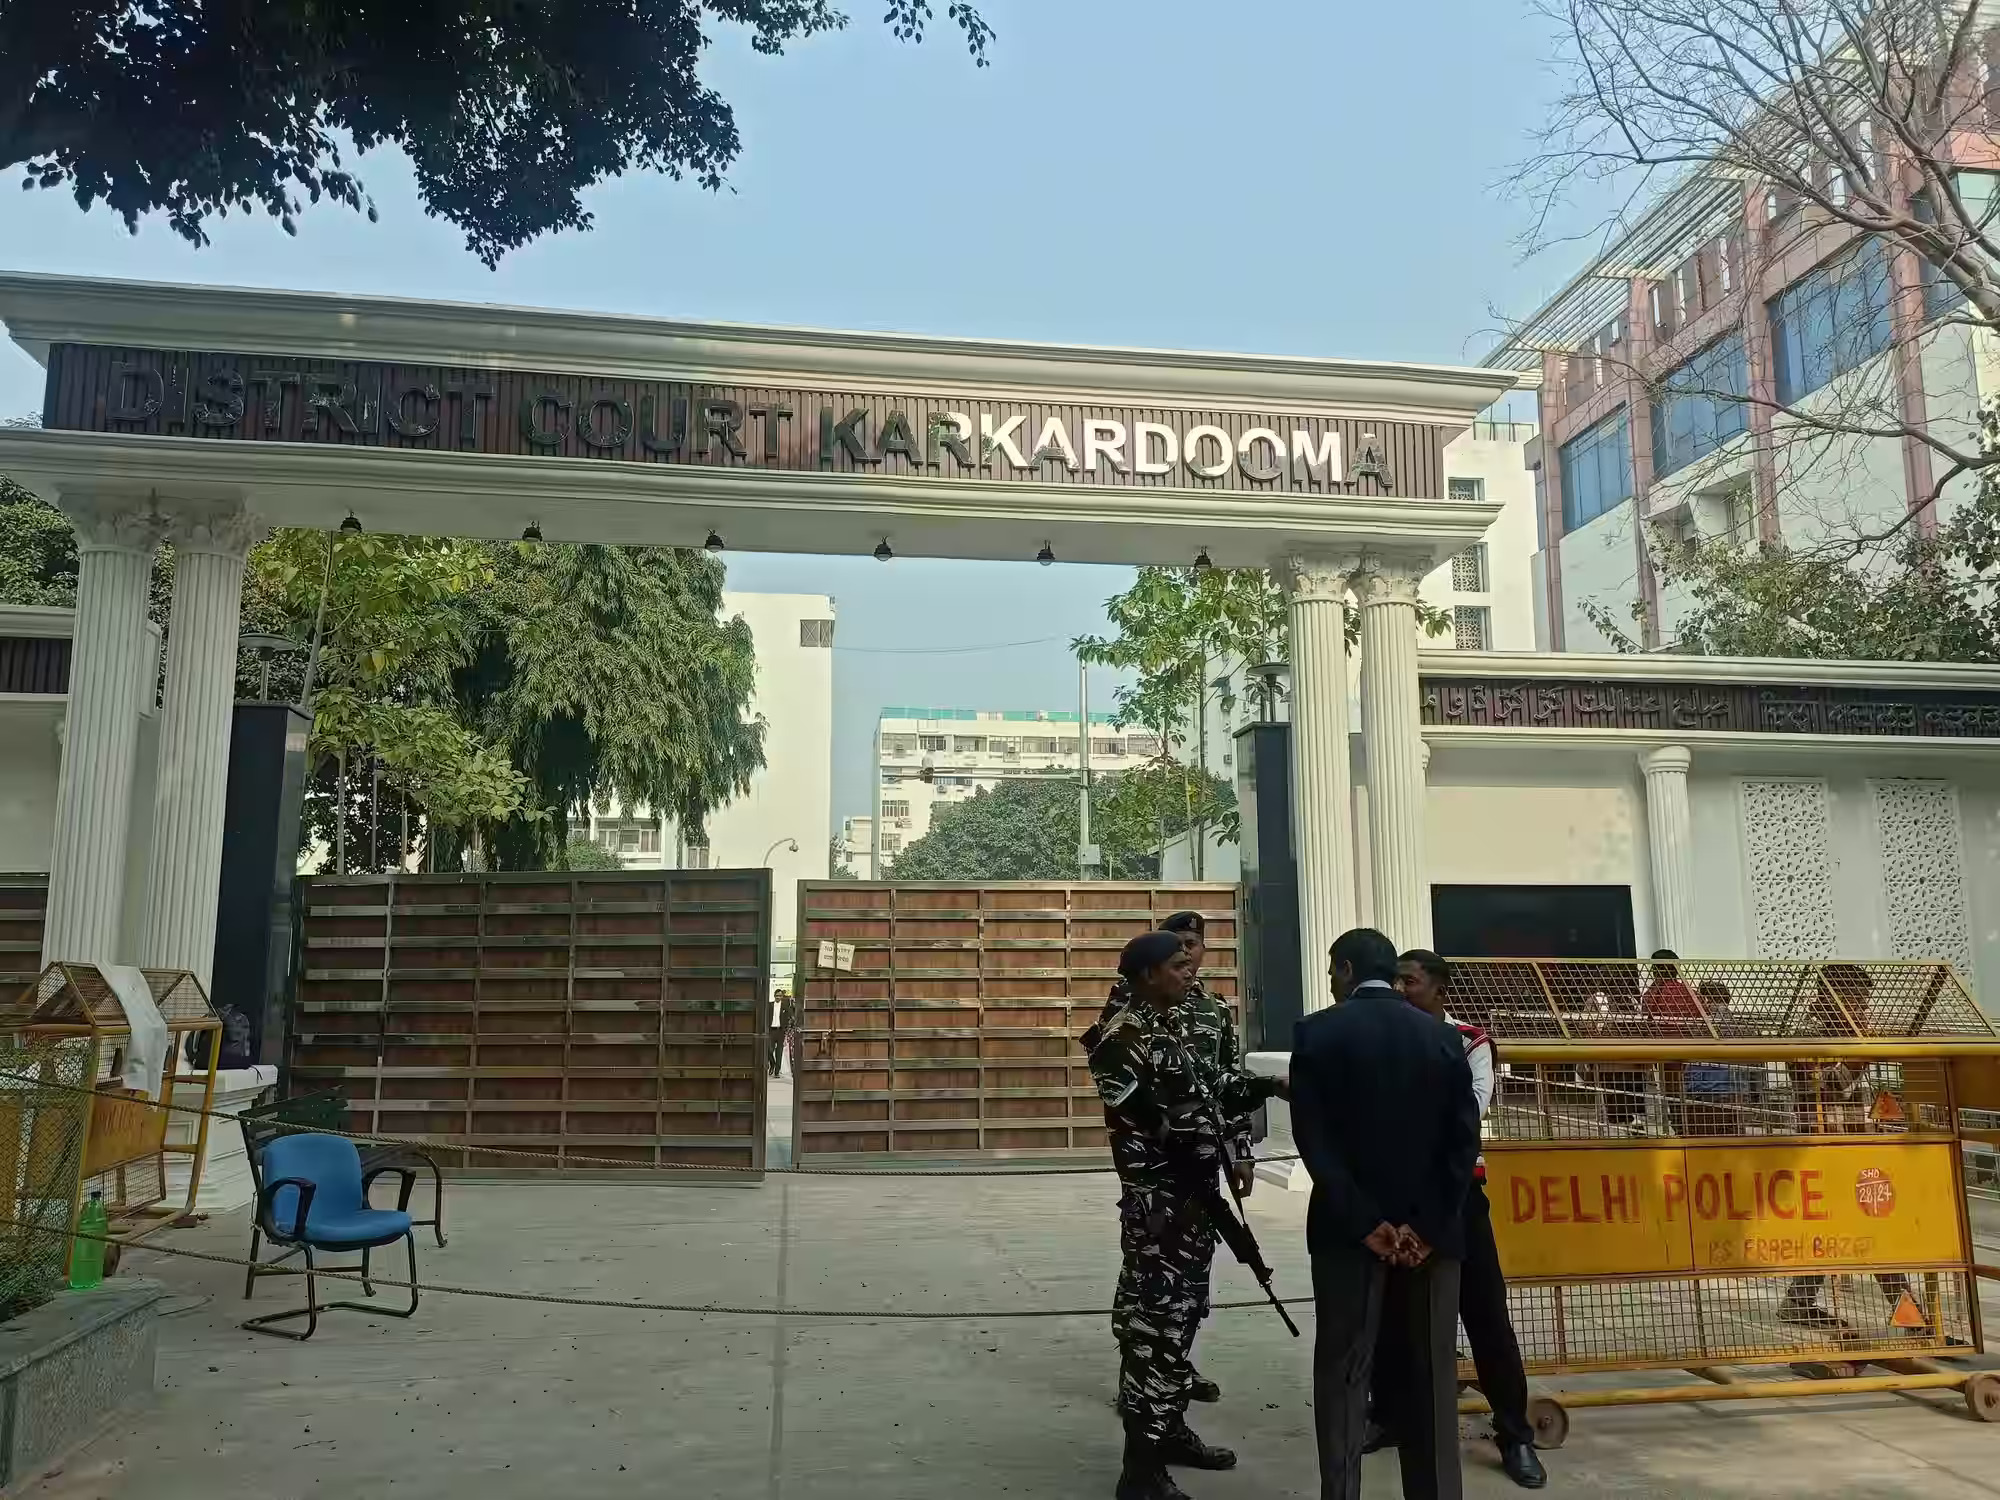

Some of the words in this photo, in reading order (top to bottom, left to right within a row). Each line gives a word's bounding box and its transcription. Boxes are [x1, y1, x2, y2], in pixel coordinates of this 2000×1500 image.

[106, 360, 495, 443] DISTRICT
[521, 393, 795, 458] COURT
[819, 406, 1394, 489] KARKARDOOMA
[1510, 1174, 1641, 1224] DELHI
[1662, 1169, 1829, 1222] POLICE
[1861, 1168, 1881, 1179] SHO
